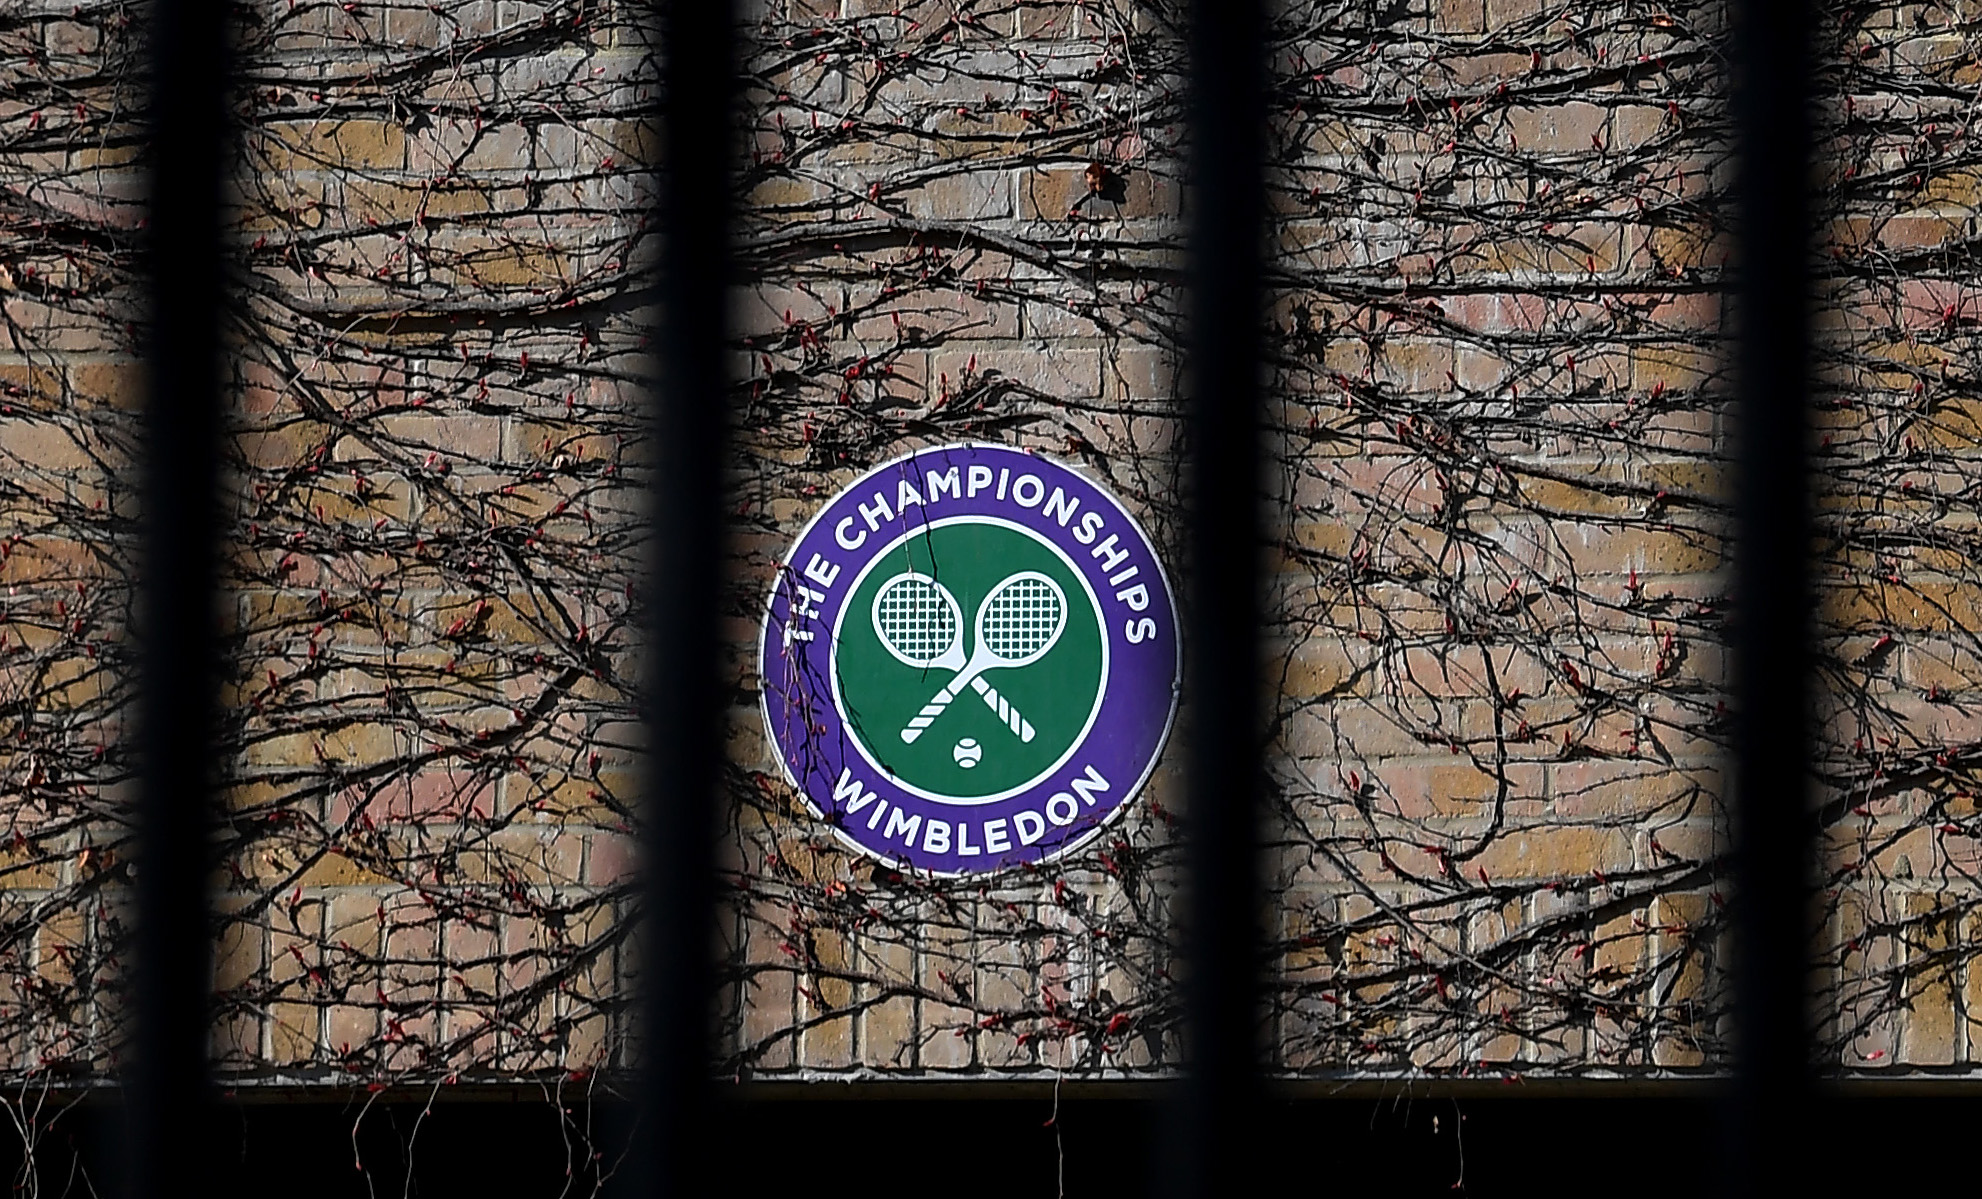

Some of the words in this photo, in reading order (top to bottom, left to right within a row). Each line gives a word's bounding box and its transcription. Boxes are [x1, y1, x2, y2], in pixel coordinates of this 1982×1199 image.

[783, 553, 841, 646] THE
[835, 465, 1156, 644] CHAMPIONSHIPS
[833, 765, 1110, 856] WIMBLEDON
